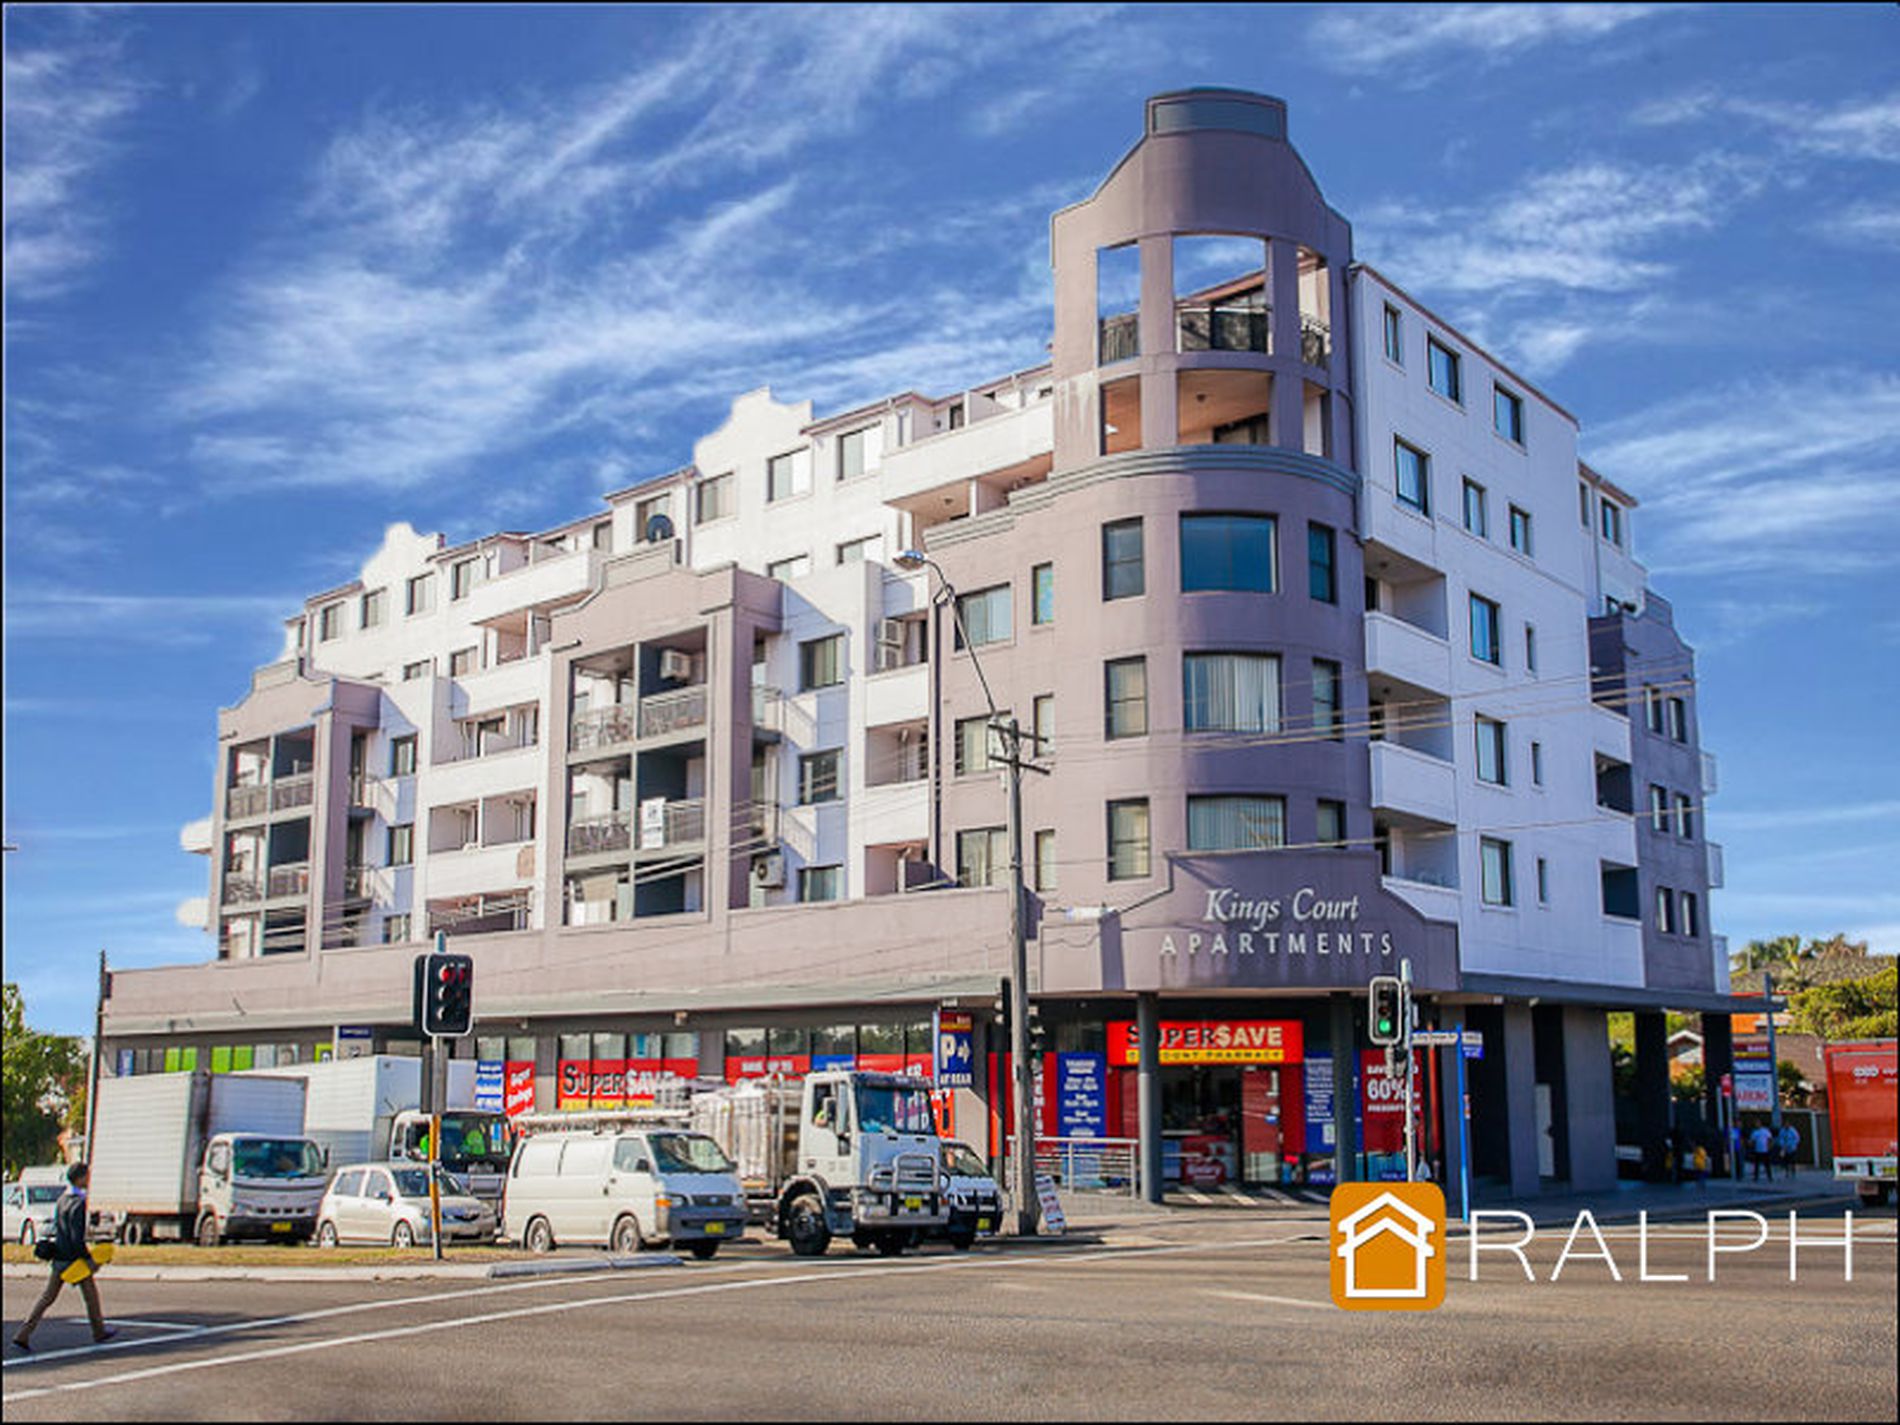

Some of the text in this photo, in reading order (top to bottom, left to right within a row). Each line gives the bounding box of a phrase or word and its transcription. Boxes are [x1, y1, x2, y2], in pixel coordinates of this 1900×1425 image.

[1203, 887, 1359, 932] Kings Court
[1159, 932, 1393, 955] APARTMENTS
[940, 1034, 956, 1070] P
